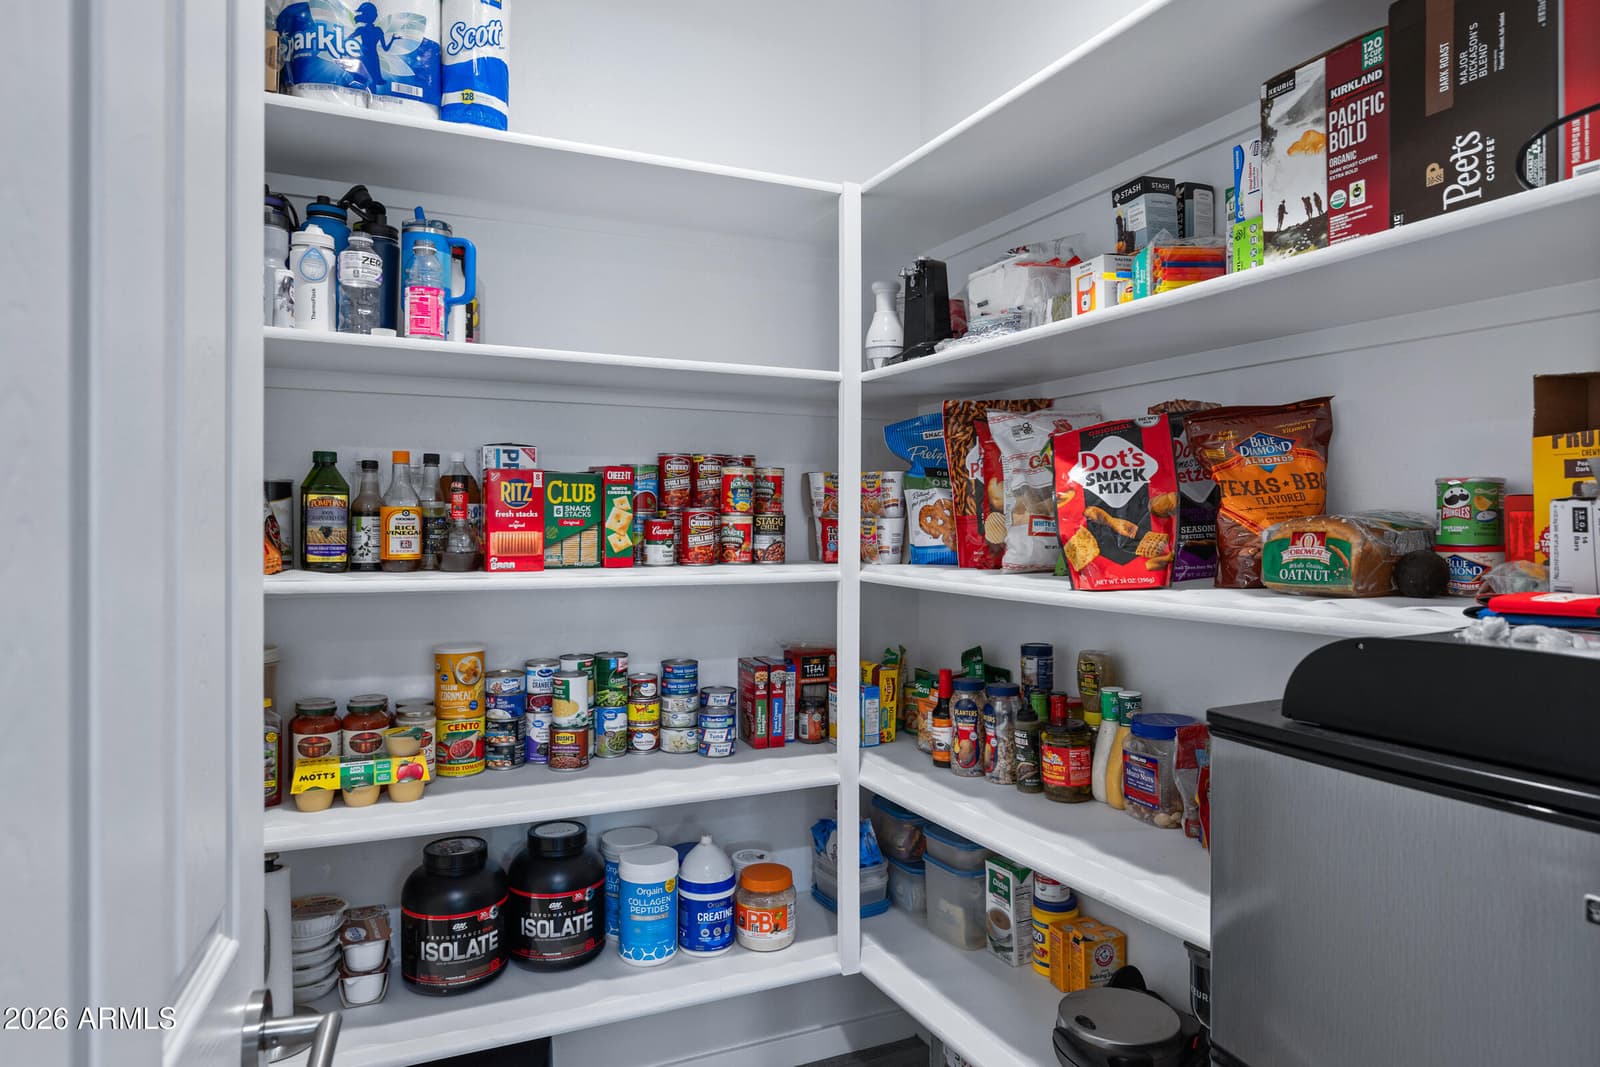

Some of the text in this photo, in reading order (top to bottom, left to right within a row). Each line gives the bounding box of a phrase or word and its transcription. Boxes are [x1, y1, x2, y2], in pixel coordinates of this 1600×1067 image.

[448, 20, 503, 56] Scott
[1363, 36, 1382, 54] 120
[1468, 22, 1478, 80] DICKASON'S
[1364, 54, 1382, 68] PODS
[1440, 42, 1450, 92] DARK ROAST
[1459, 51, 1468, 85] MAJOR
[1478, 44, 1488, 77] BLEND
[1268, 80, 1295, 97] KEURIG
[1330, 69, 1383, 100] KIRKLAND
[462, 92, 474, 101] 128
[1329, 91, 1384, 132] PACIFIC
[1330, 120, 1366, 154] BOLD
[1329, 150, 1357, 168] ORGANIC
[1486, 138, 1495, 182] COFFEE
[1443, 130, 1484, 210] Peet's
[1120, 184, 1142, 199] STASH
[362, 256, 382, 267] ZER
[1283, 425, 1306, 434] Vitamin
[1240, 441, 1292, 457] DIAMOND
[1250, 436, 1274, 448] BLUE
[1081, 448, 1145, 472] Dot's
[1244, 455, 1294, 466] ALMONDS
[1086, 468, 1148, 486] SNACK
[501, 481, 532, 502] RITZ
[547, 480, 596, 504] CLUB
[1098, 482, 1132, 494] MIX
[1220, 477, 1281, 498] TEXAS
[1256, 492, 1306, 506] FLAVORED
[556, 507, 562, 516] 6
[1442, 506, 1470, 519] PRINGLES
[756, 517, 784, 526] STAGG
[1280, 569, 1330, 582] OATNUT
[803, 664, 825, 674] THAI
[447, 722, 480, 732] CENTO
[299, 772, 336, 782] MOTT'S
[636, 887, 662, 897] Orgain
[628, 895, 671, 906] COLLAGEN
[630, 904, 670, 914] PEPTIDES
[697, 906, 733, 921] CREATINE
[521, 911, 593, 938] ISOLATE
[421, 929, 498, 961] ISOLATE
